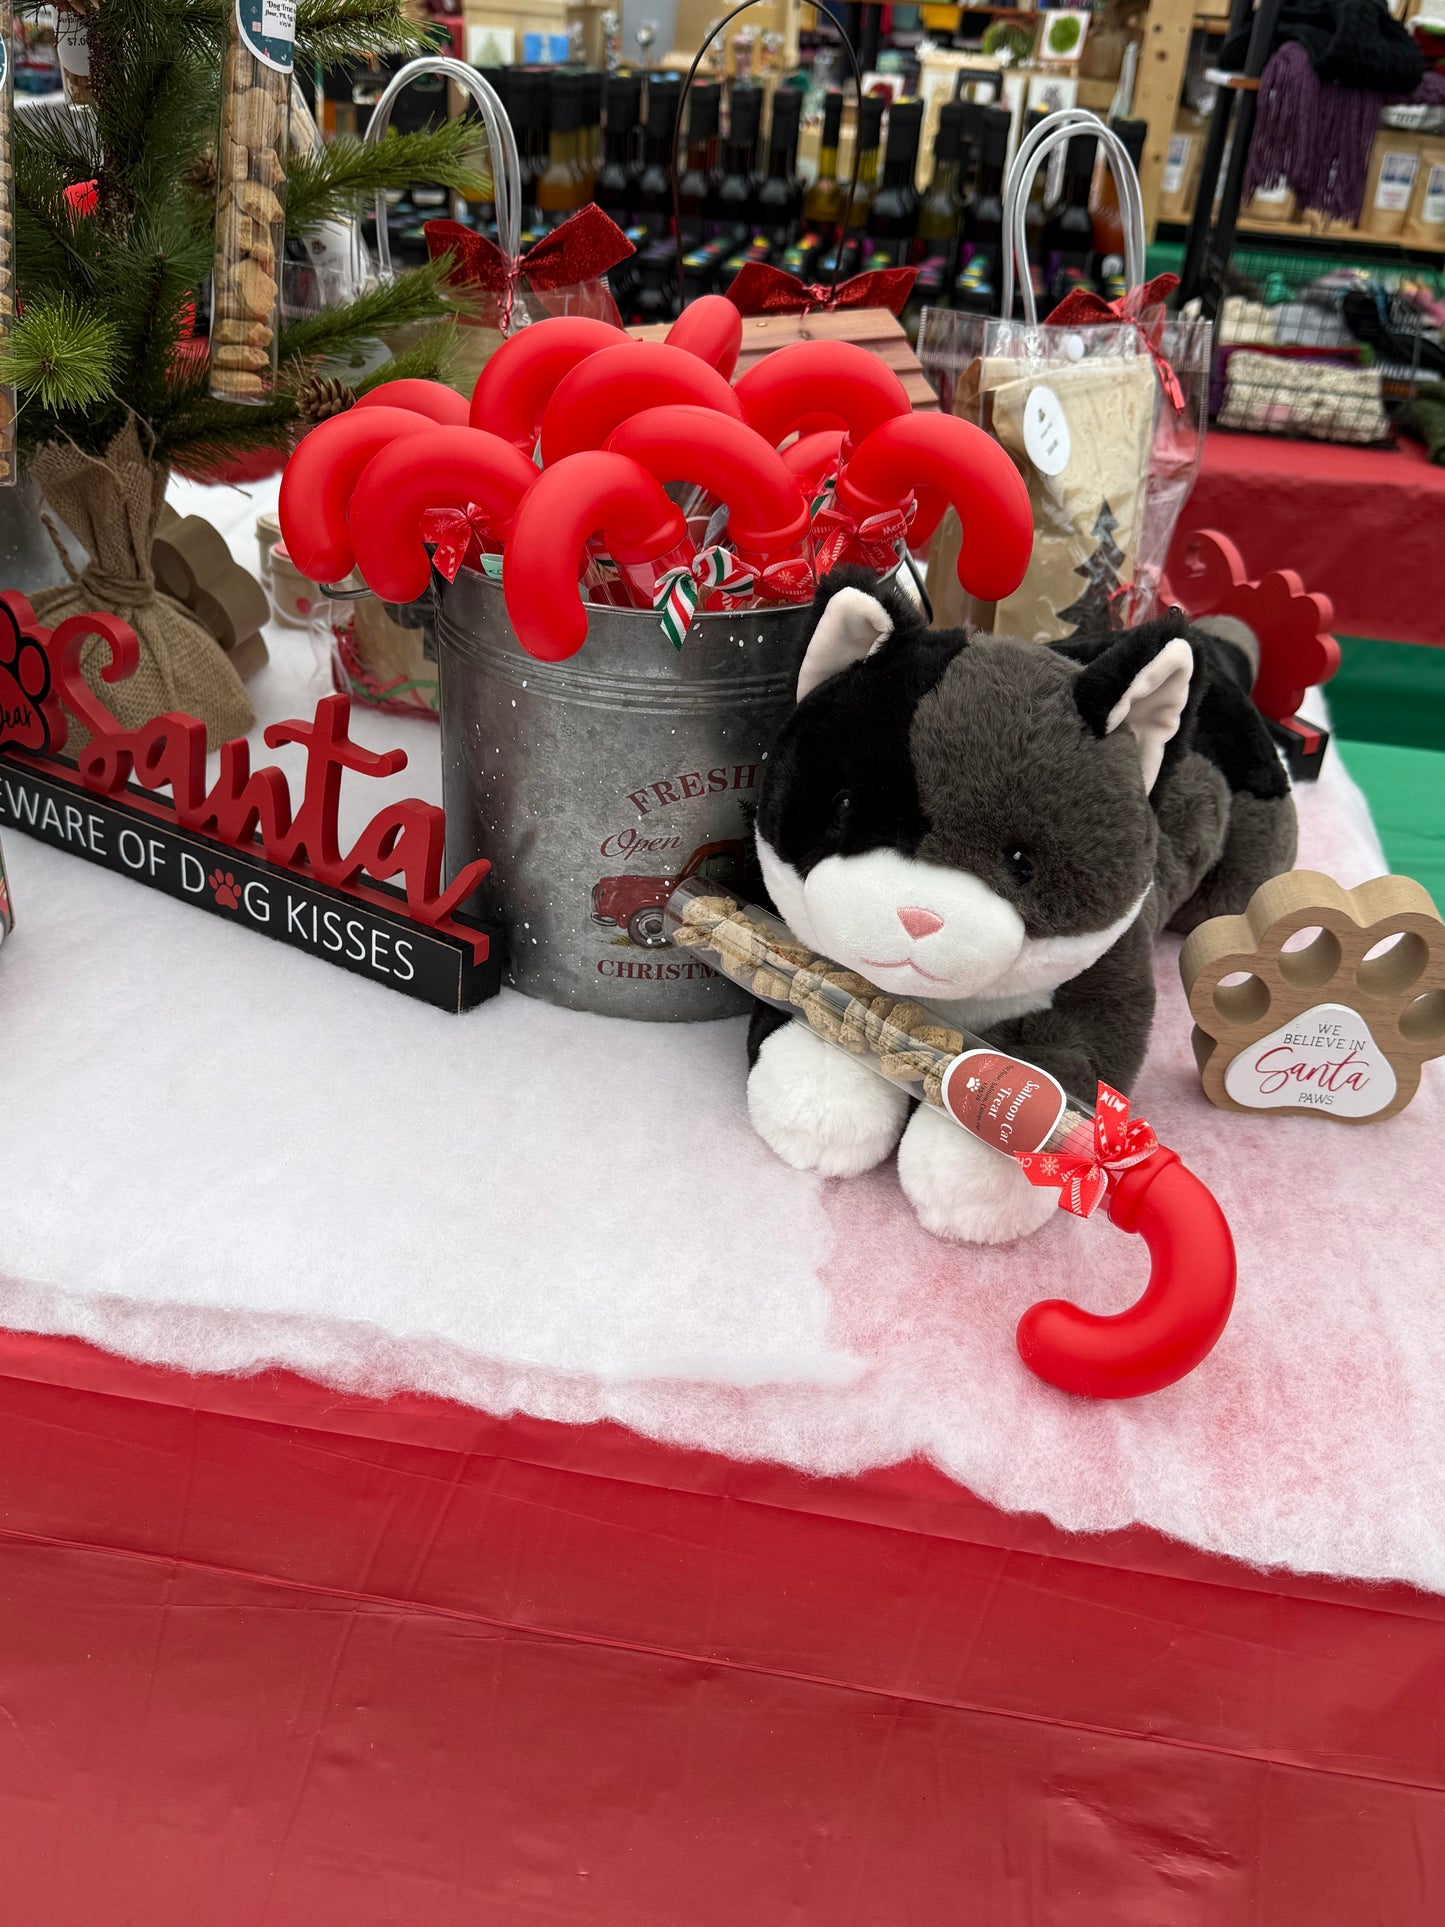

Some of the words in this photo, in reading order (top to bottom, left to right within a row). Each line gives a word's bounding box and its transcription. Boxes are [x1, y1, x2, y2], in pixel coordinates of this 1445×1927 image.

[50, 612, 491, 918] Santa
[626, 764, 760, 817] FRESH
[600, 828, 682, 861] Open
[119, 829, 167, 877] OF
[287, 895, 415, 980] KISSES
[1283, 1033, 1346, 1050] BELIEVE
[1348, 1039, 1366, 1051] IN
[1318, 1023, 1342, 1036] WE
[1255, 1046, 1371, 1094] Santa
[988, 1087, 1012, 1120] Treat
[1005, 1080, 1040, 1121] Salmon
[1298, 1092, 1334, 1105] PAWS
[1000, 1123, 1013, 1144] Cat
